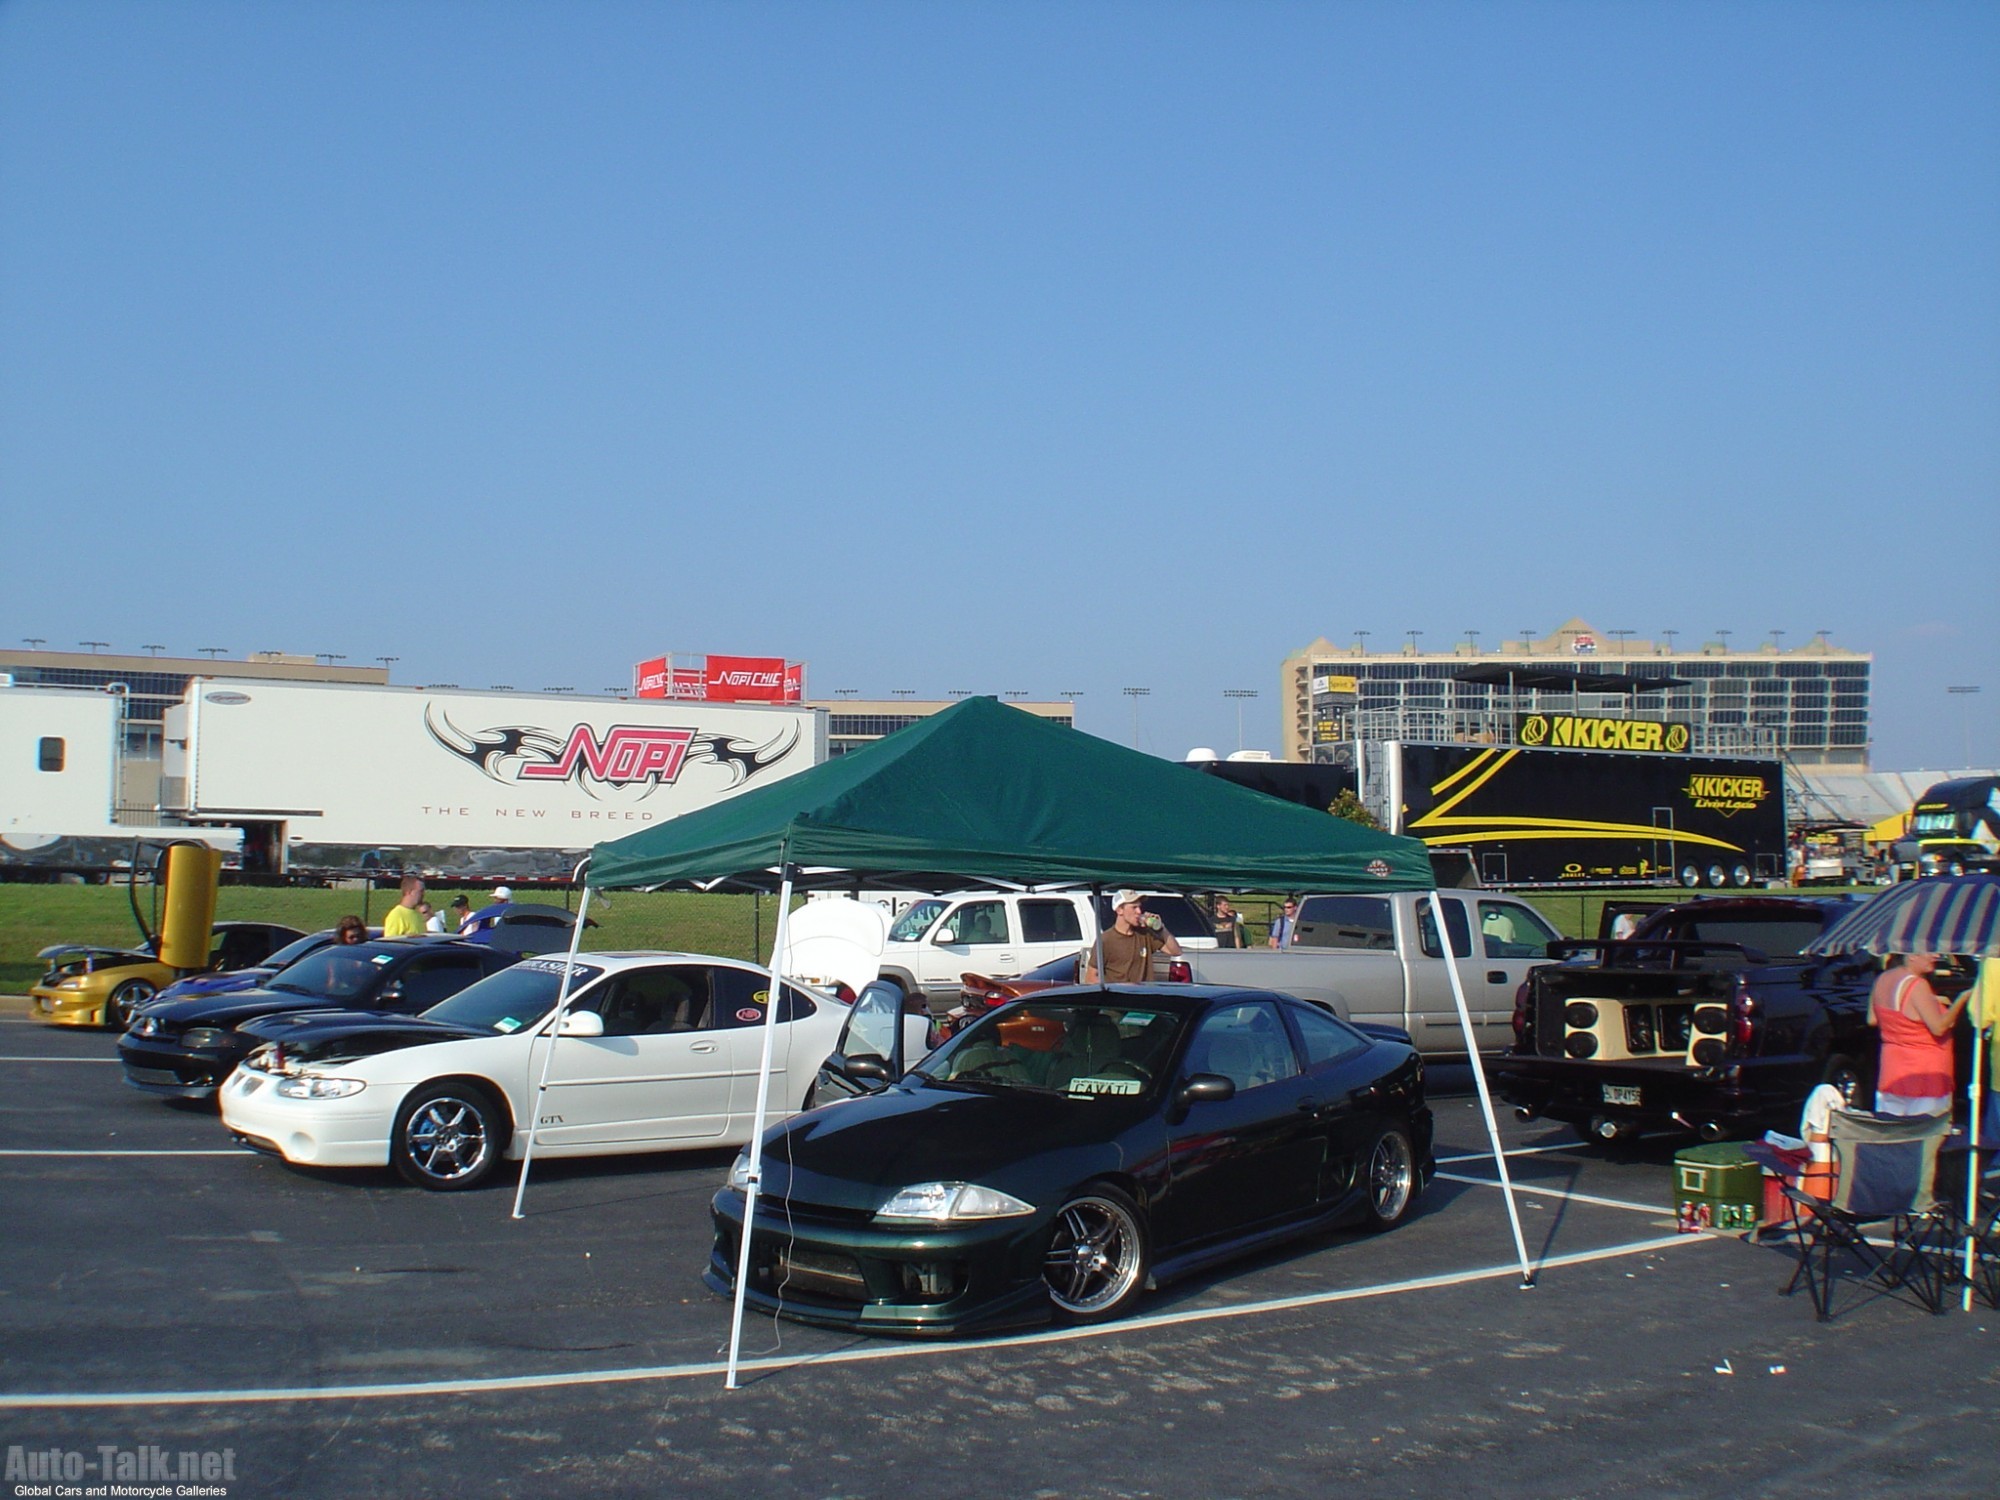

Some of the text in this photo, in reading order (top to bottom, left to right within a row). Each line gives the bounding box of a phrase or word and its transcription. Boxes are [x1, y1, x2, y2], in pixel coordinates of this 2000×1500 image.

[709, 671, 752, 686] NOPI
[752, 672, 782, 687] CHIC
[517, 723, 699, 784] NOPI
[421, 806, 653, 820] THE NEW BREED
